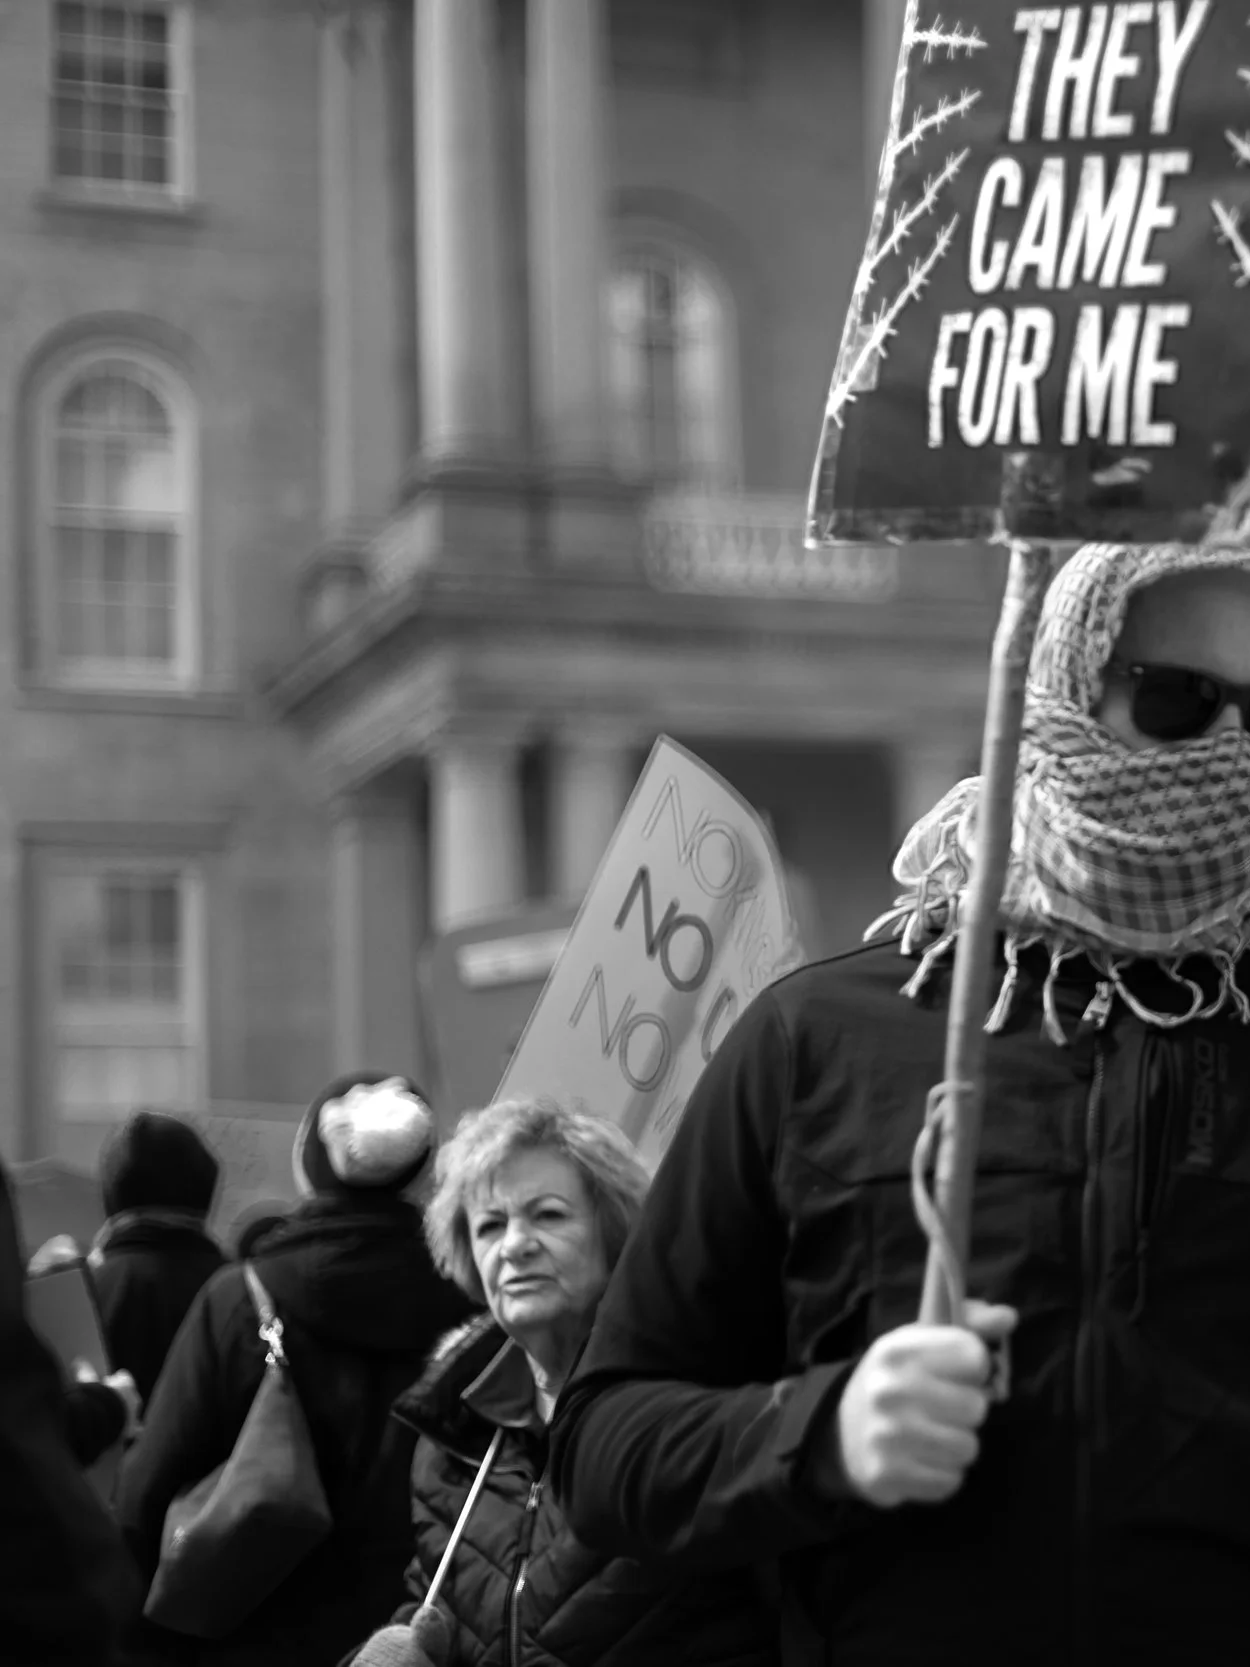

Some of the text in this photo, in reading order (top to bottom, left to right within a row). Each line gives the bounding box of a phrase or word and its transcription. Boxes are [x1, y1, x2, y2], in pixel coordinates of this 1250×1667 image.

[1009, 0, 1209, 141] THEY
[969, 150, 1190, 293] CAME
[928, 304, 1190, 448] FOR ME
[641, 775, 743, 899] NO
[612, 864, 714, 993] NO
[567, 964, 672, 1092] NO
[1186, 1036, 1215, 1167] MOSKO
